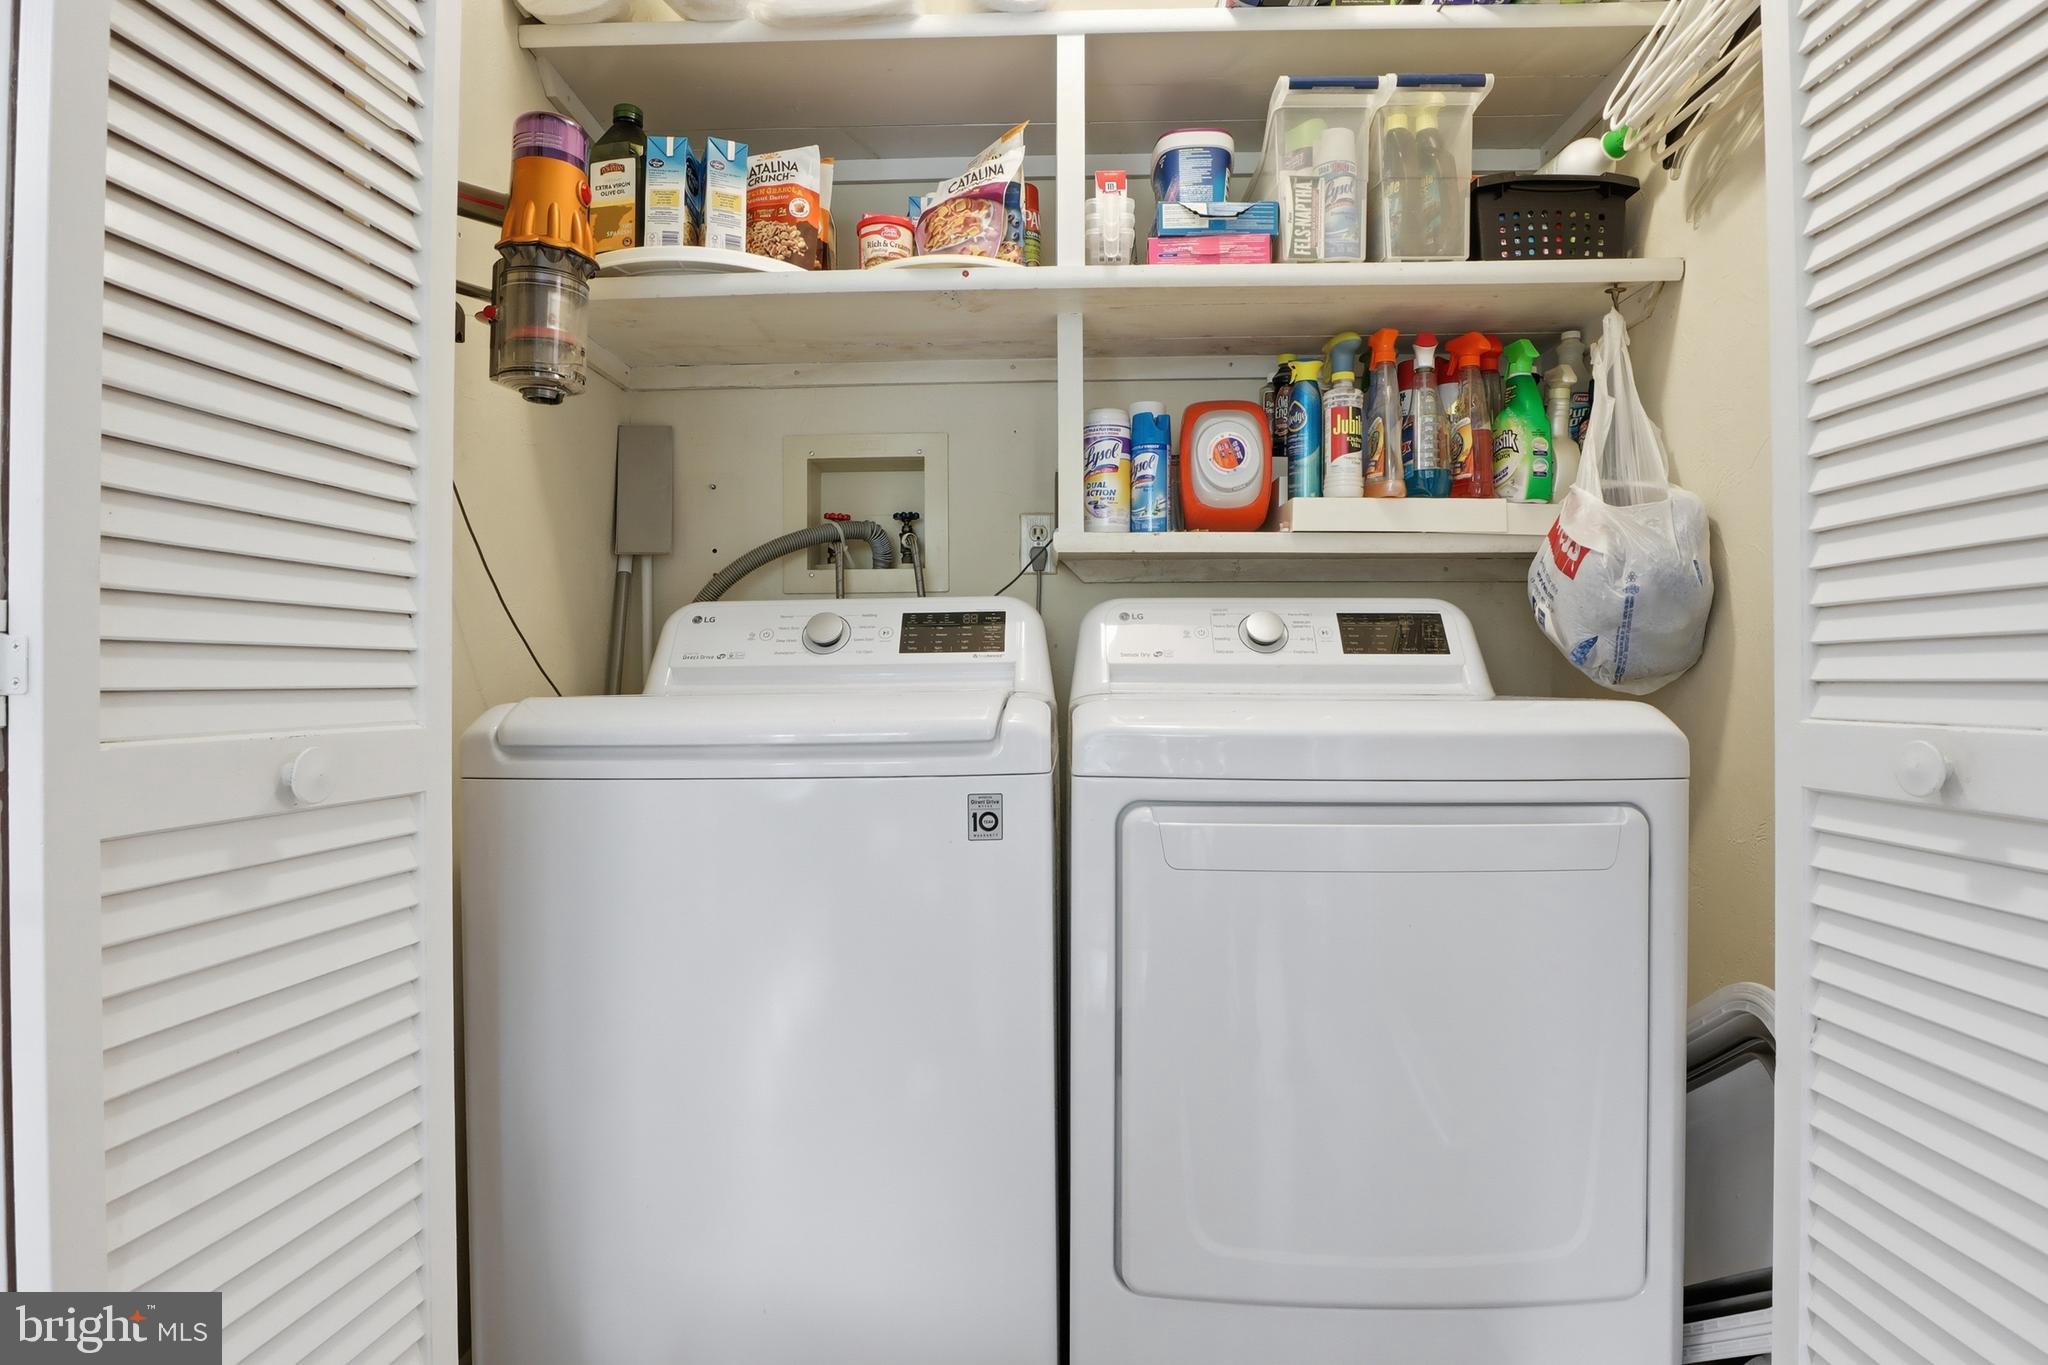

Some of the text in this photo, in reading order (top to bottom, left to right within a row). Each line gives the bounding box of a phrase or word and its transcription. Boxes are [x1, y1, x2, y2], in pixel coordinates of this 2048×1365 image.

[746, 160, 799, 181] ATALINA
[748, 172, 789, 187] CRUNCH
[948, 163, 1004, 194] CATALINA
[595, 181, 632, 192] EXTRA VIRGIN
[600, 190, 616, 198] OLIVE
[1023, 209, 1041, 231] PA
[1294, 181, 1313, 257] FELS-NAPTHA
[867, 240, 882, 249] Rich
[882, 240, 889, 248] &
[1332, 404, 1363, 436] Jubil
[1084, 442, 1120, 472] Lysol
[1132, 454, 1155, 483] ysol
[1087, 481, 1107, 490] DUAL
[1087, 489, 1116, 497] ACTION
[972, 811, 999, 832] 10
